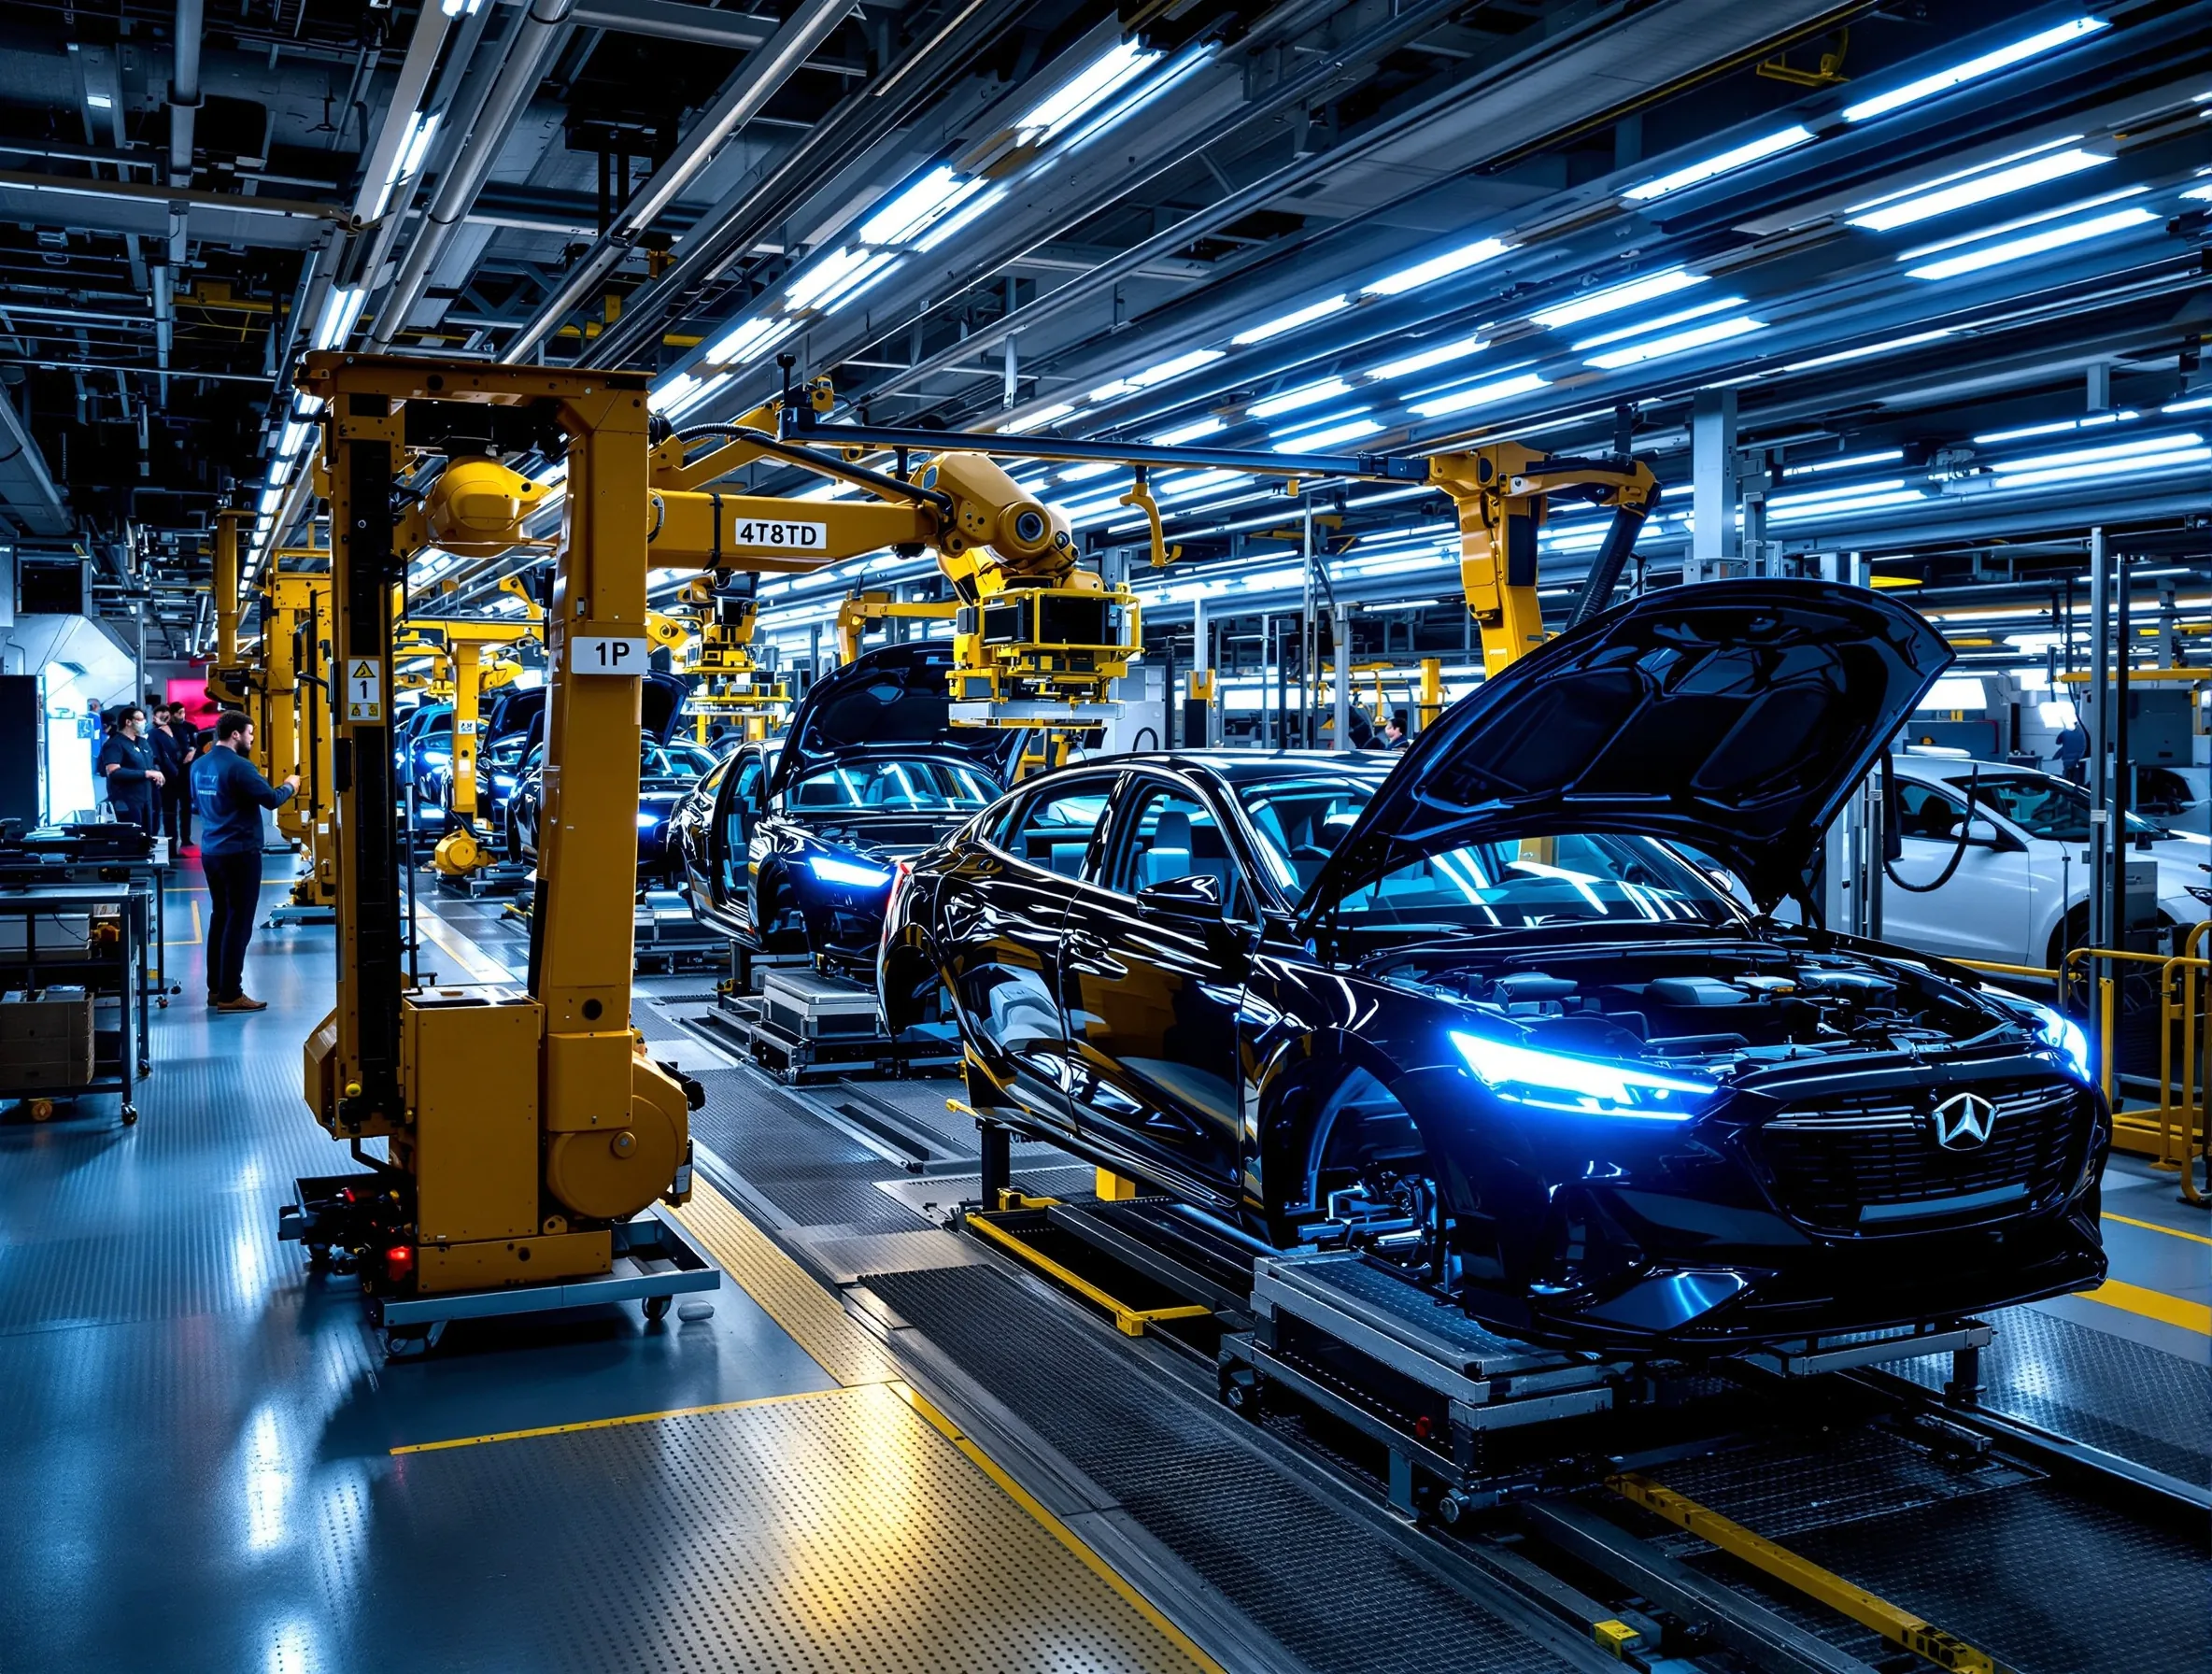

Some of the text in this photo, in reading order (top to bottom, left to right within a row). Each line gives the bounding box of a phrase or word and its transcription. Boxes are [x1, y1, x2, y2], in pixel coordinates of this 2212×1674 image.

[740, 522, 817, 546] 4T8TD
[595, 642, 631, 666] 1P
[360, 680, 368, 700] 1
